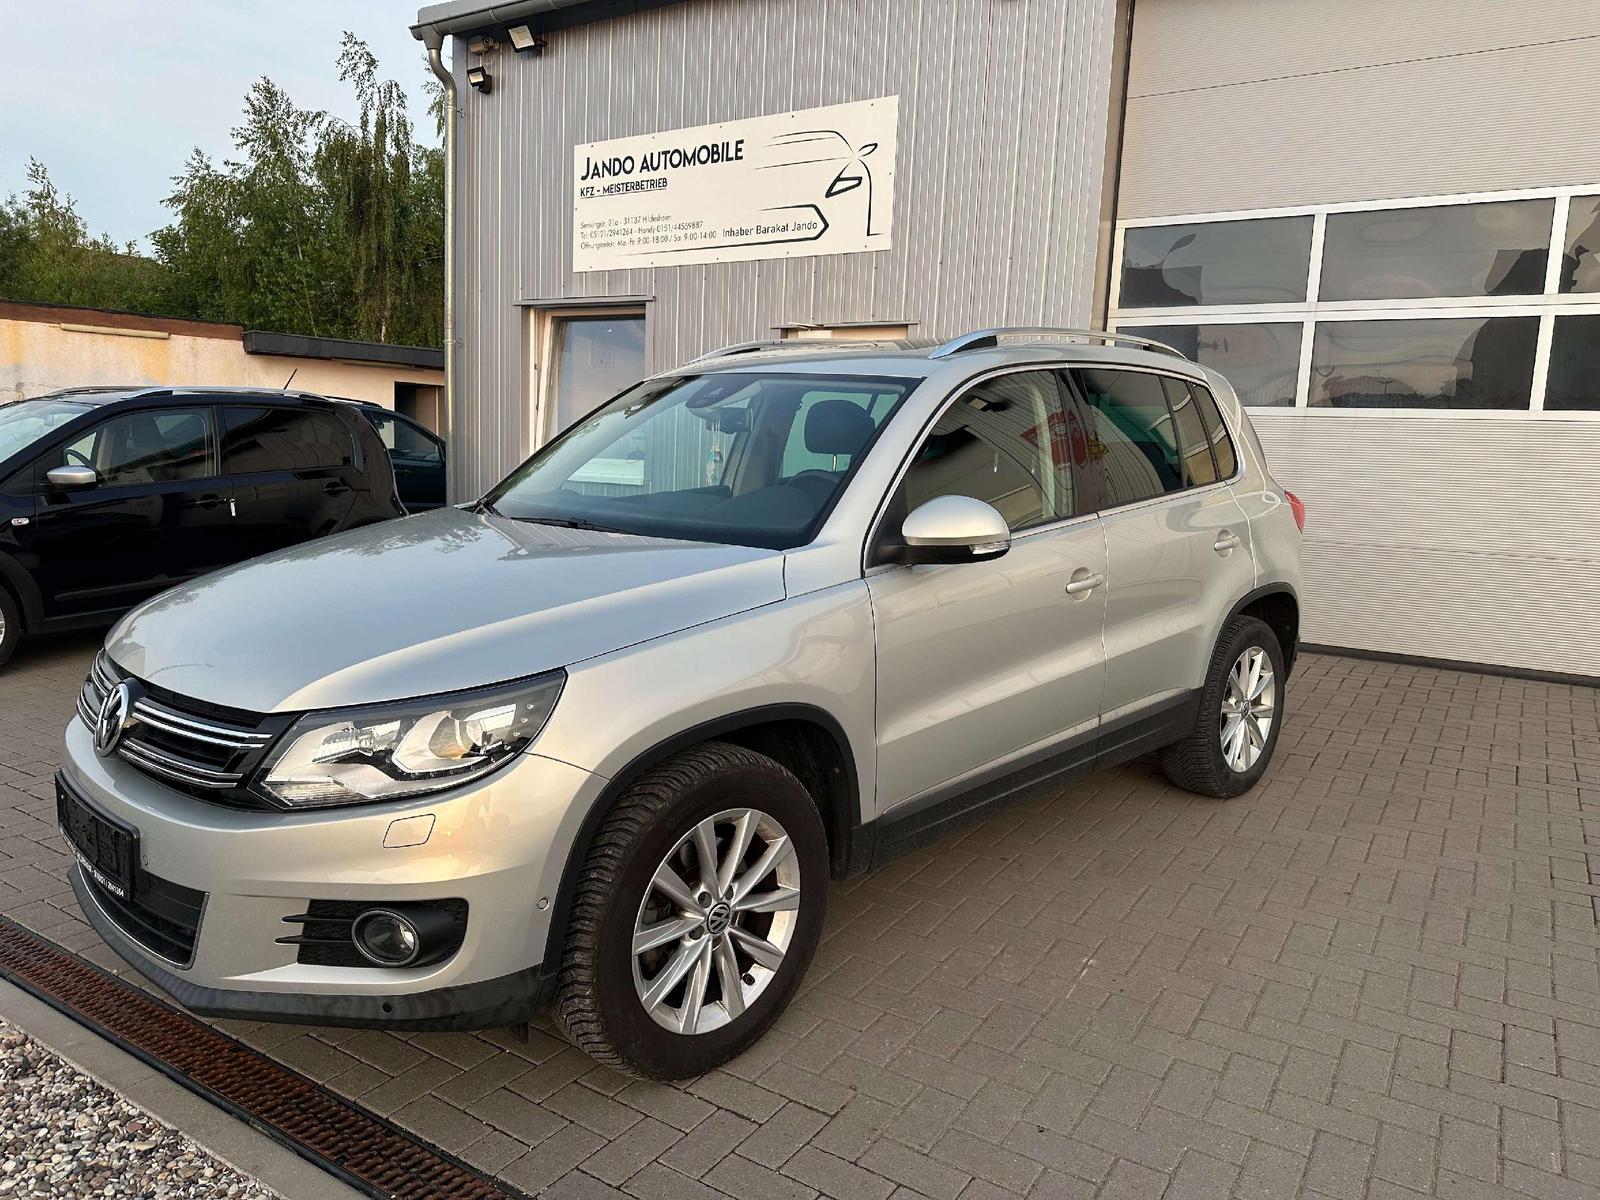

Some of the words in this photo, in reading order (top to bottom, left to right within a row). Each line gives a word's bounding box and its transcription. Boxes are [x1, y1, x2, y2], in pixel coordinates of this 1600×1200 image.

[580, 155, 635, 181] JANDO
[639, 139, 745, 173] AUTOMOBILE
[580, 186, 595, 197] KFZ
[602, 177, 668, 195] MEISTERBETRIEB
[722, 227, 754, 238] Inhaber
[756, 223, 789, 235] Barakat
[791, 220, 818, 232] Jando
